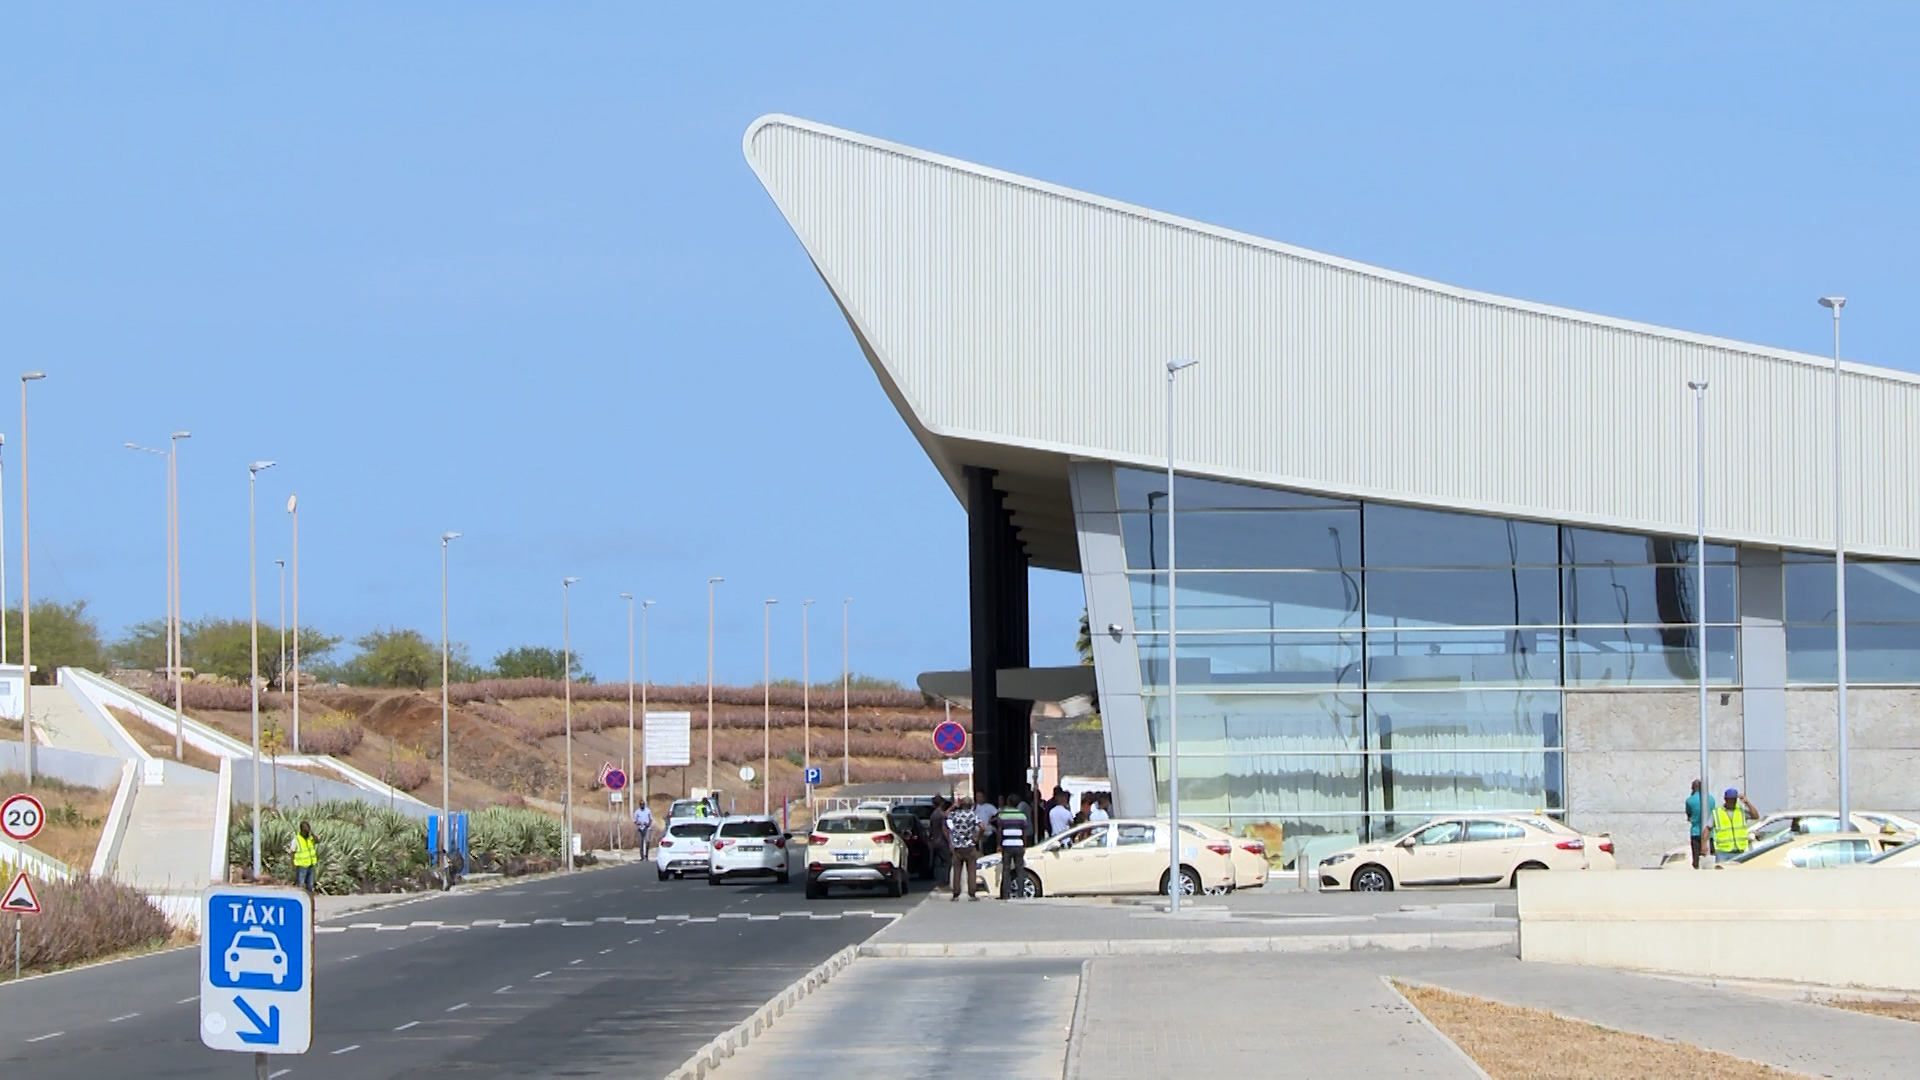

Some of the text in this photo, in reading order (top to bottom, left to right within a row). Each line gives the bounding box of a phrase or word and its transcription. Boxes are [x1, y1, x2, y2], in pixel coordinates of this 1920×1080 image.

[808, 769, 818, 782] P
[8, 809, 37, 827] 20
[228, 899, 285, 926] TÁXI
